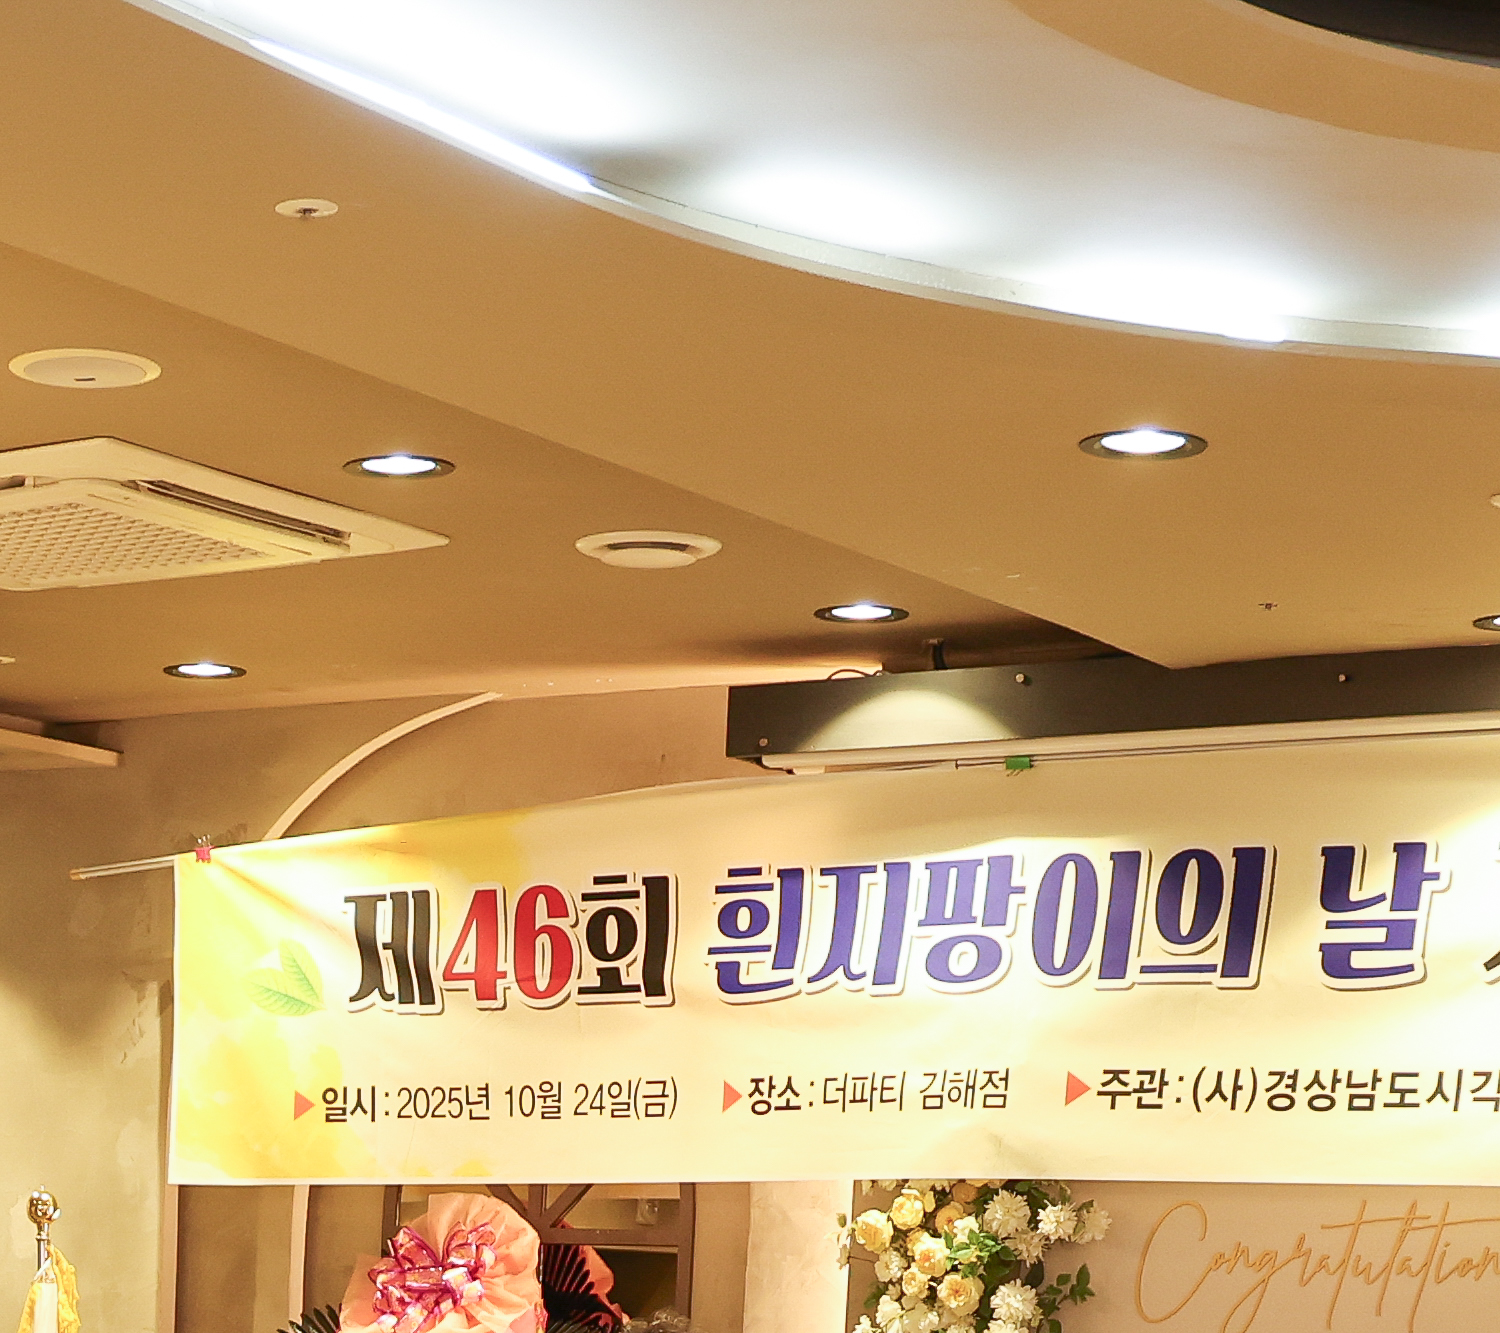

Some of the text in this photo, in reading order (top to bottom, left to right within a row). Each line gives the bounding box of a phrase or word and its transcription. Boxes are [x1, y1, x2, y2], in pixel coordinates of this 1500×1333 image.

[344, 874, 674, 1005] 제46회
[707, 846, 1268, 995] 흰지팡이의
[1319, 841, 1439, 979] 날
[396, 1084, 491, 1122] 2025년
[504, 1081, 564, 1121] 10월
[573, 1077, 679, 1122] 24일(금)
[822, 1070, 905, 1113] 더파티
[920, 1067, 1010, 1112] 김해점
